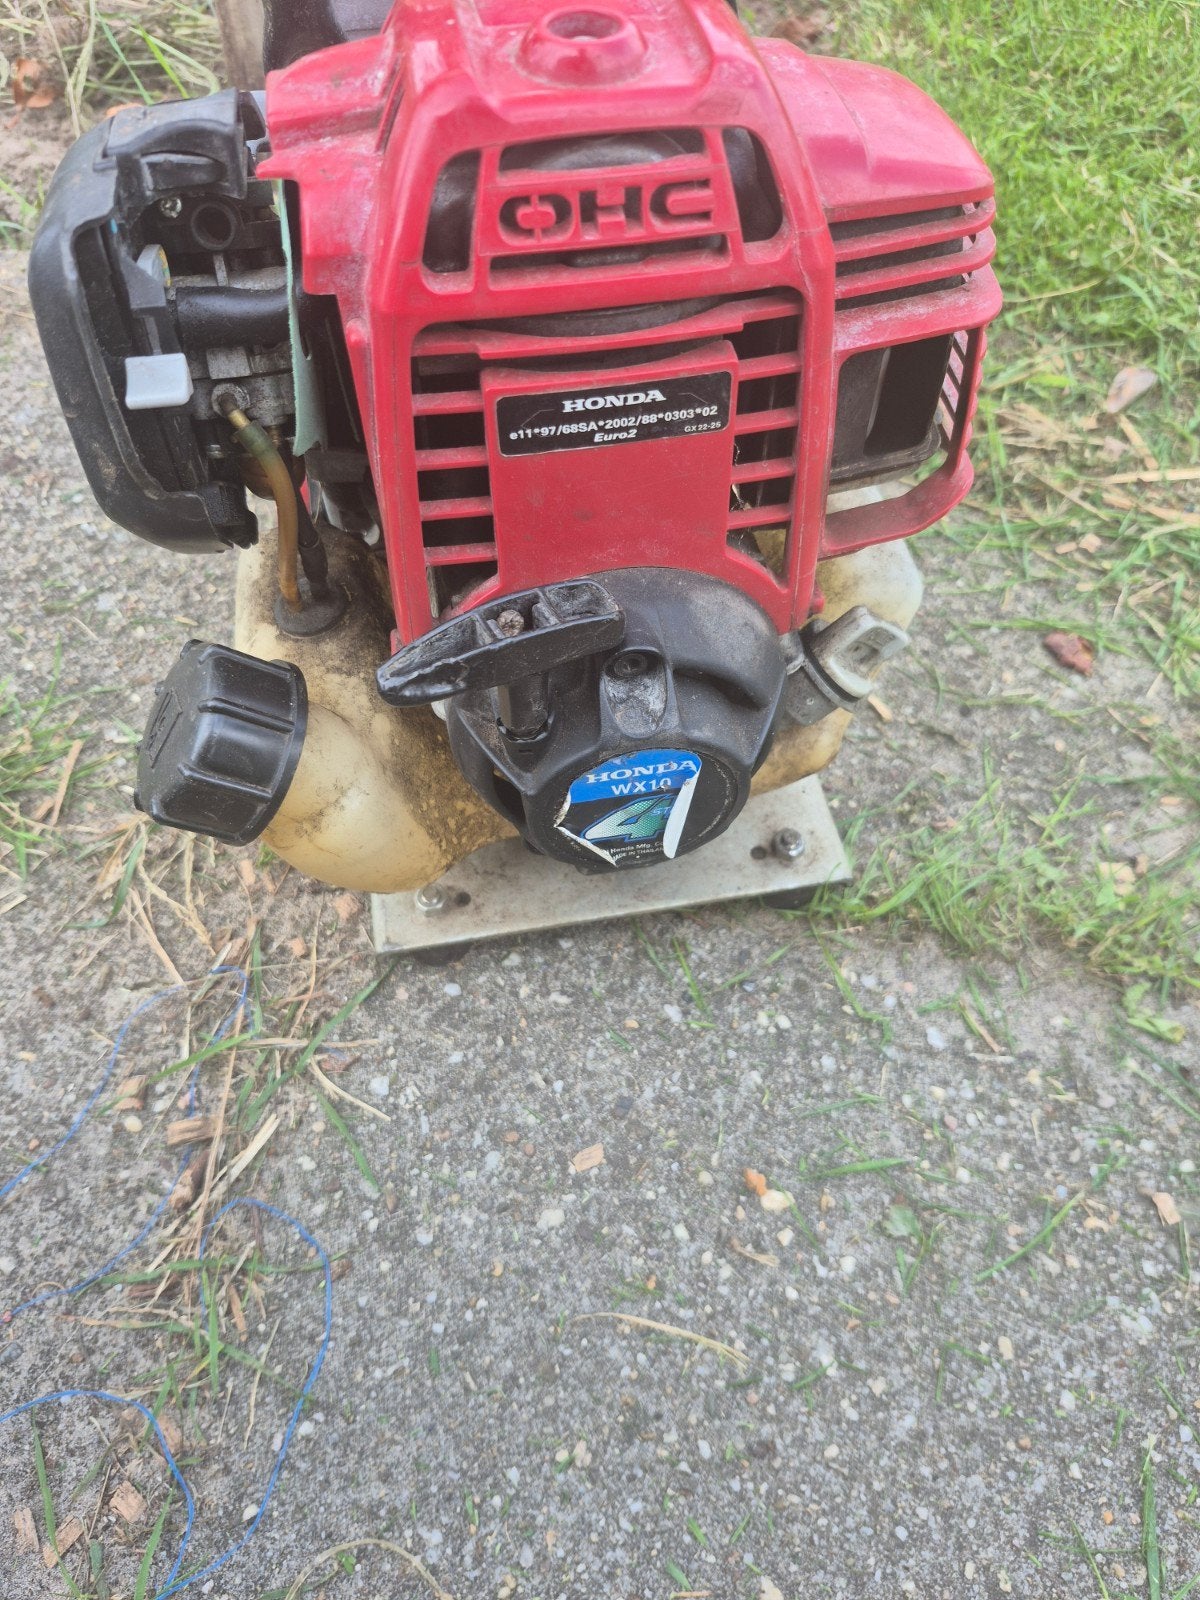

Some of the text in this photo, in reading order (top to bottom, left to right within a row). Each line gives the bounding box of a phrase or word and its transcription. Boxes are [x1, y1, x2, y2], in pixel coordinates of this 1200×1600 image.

[499, 178, 714, 246] OHC
[562, 389, 667, 413] HONDA
[698, 421, 721, 431] 22-25
[593, 429, 638, 443] Euro2
[586, 760, 698, 784] HONDA
[611, 777, 672, 796] WX10
[610, 845, 635, 854] Honda
